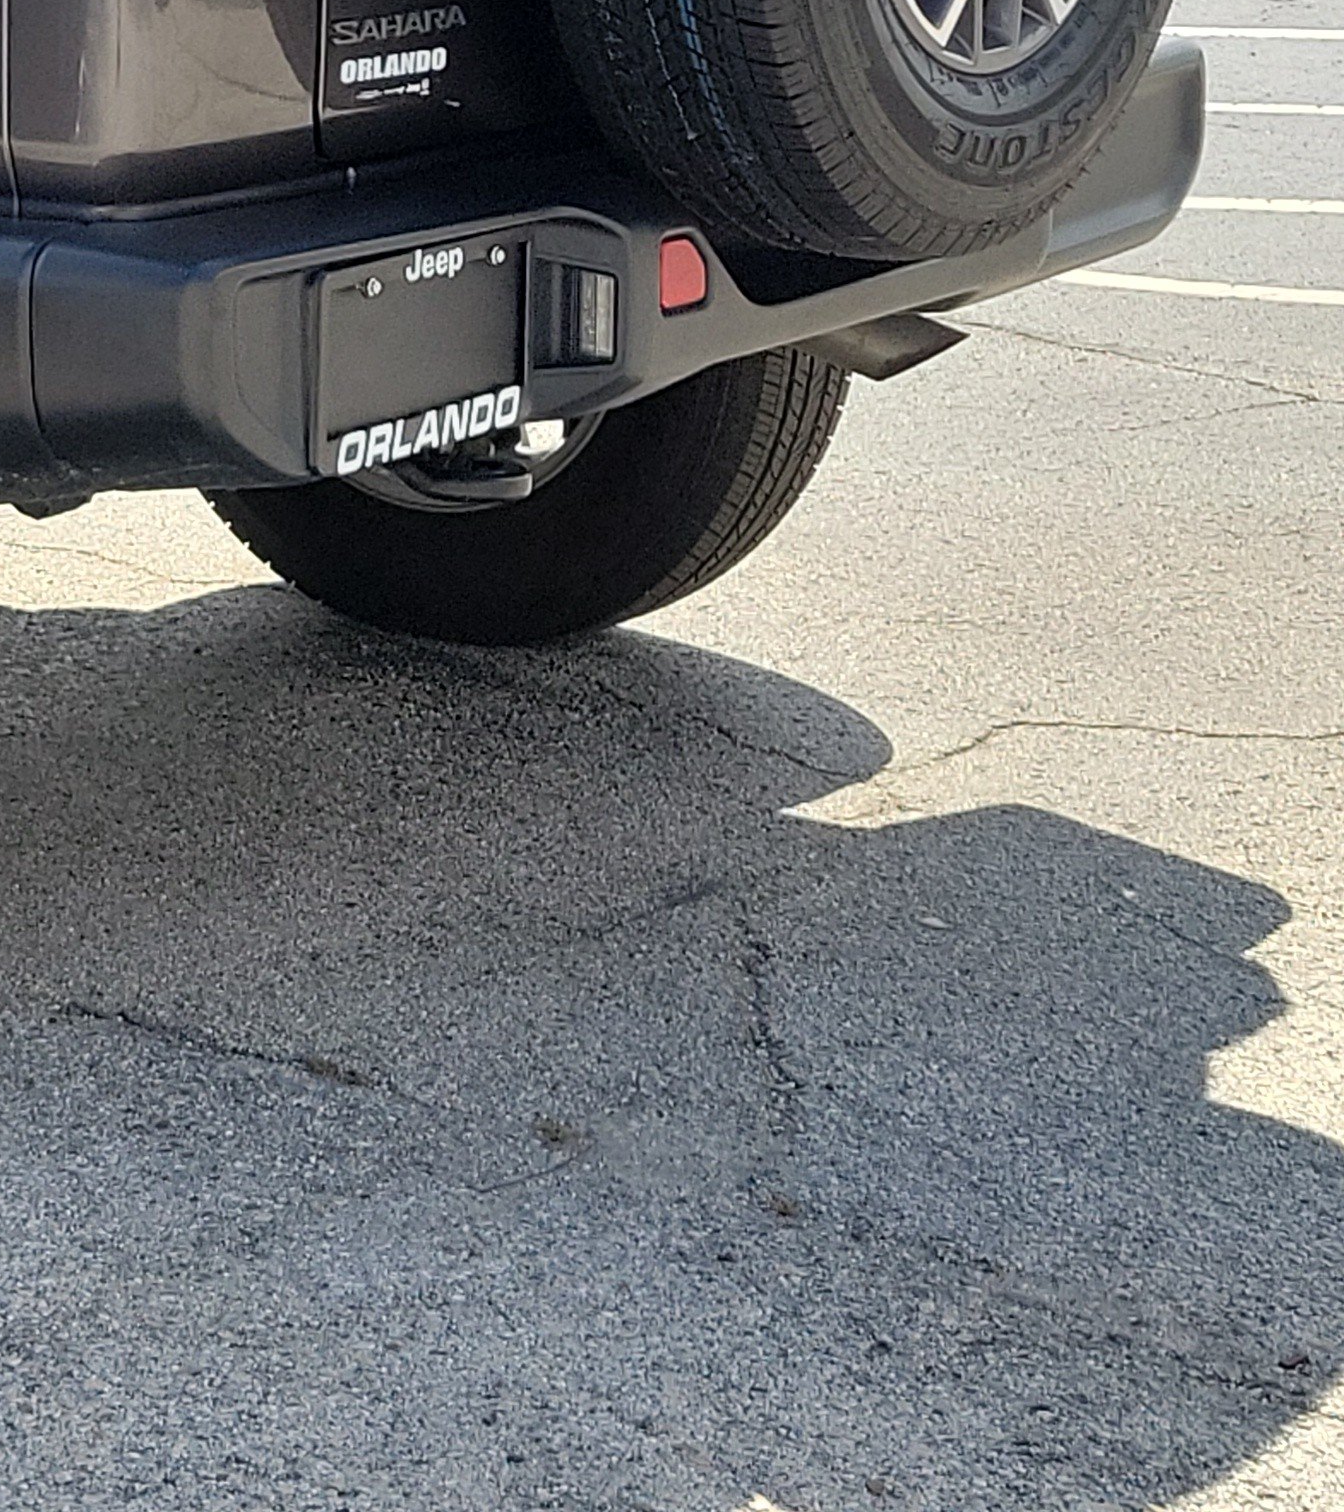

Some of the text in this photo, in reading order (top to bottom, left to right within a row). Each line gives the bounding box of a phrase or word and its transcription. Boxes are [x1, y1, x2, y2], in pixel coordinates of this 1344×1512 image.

[332, 5, 466, 45] SAHARA
[340, 46, 447, 84] ORLANDO
[405, 246, 464, 282] Jeep
[337, 385, 521, 476] ORLANDO
